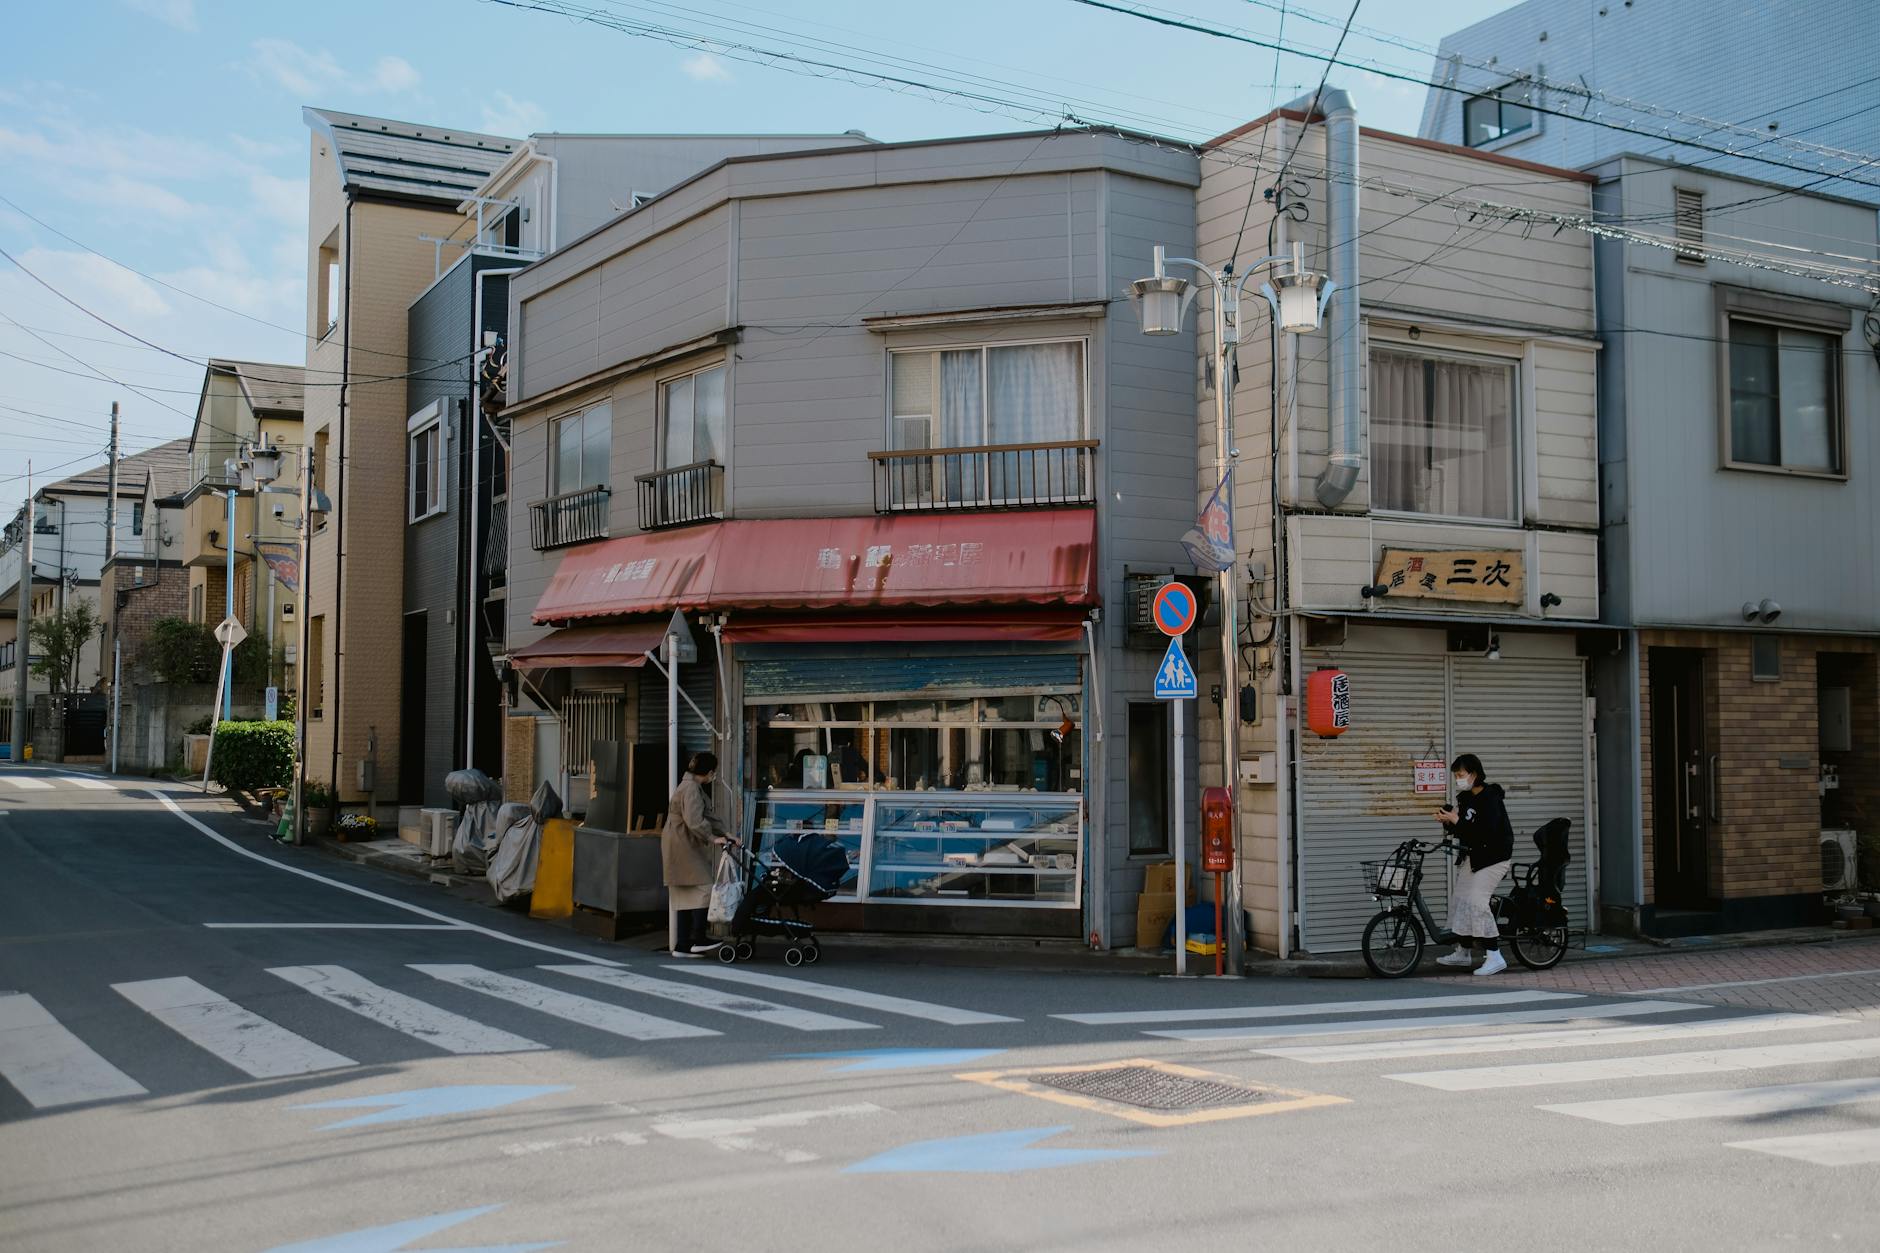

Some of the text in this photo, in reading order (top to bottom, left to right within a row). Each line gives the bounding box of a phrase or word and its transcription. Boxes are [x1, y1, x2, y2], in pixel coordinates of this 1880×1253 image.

[1388, 556, 1511, 591] 居酒屋 三次
[1332, 673, 1350, 728] 居酒屋
[1416, 770, 1446, 783] 定休日
